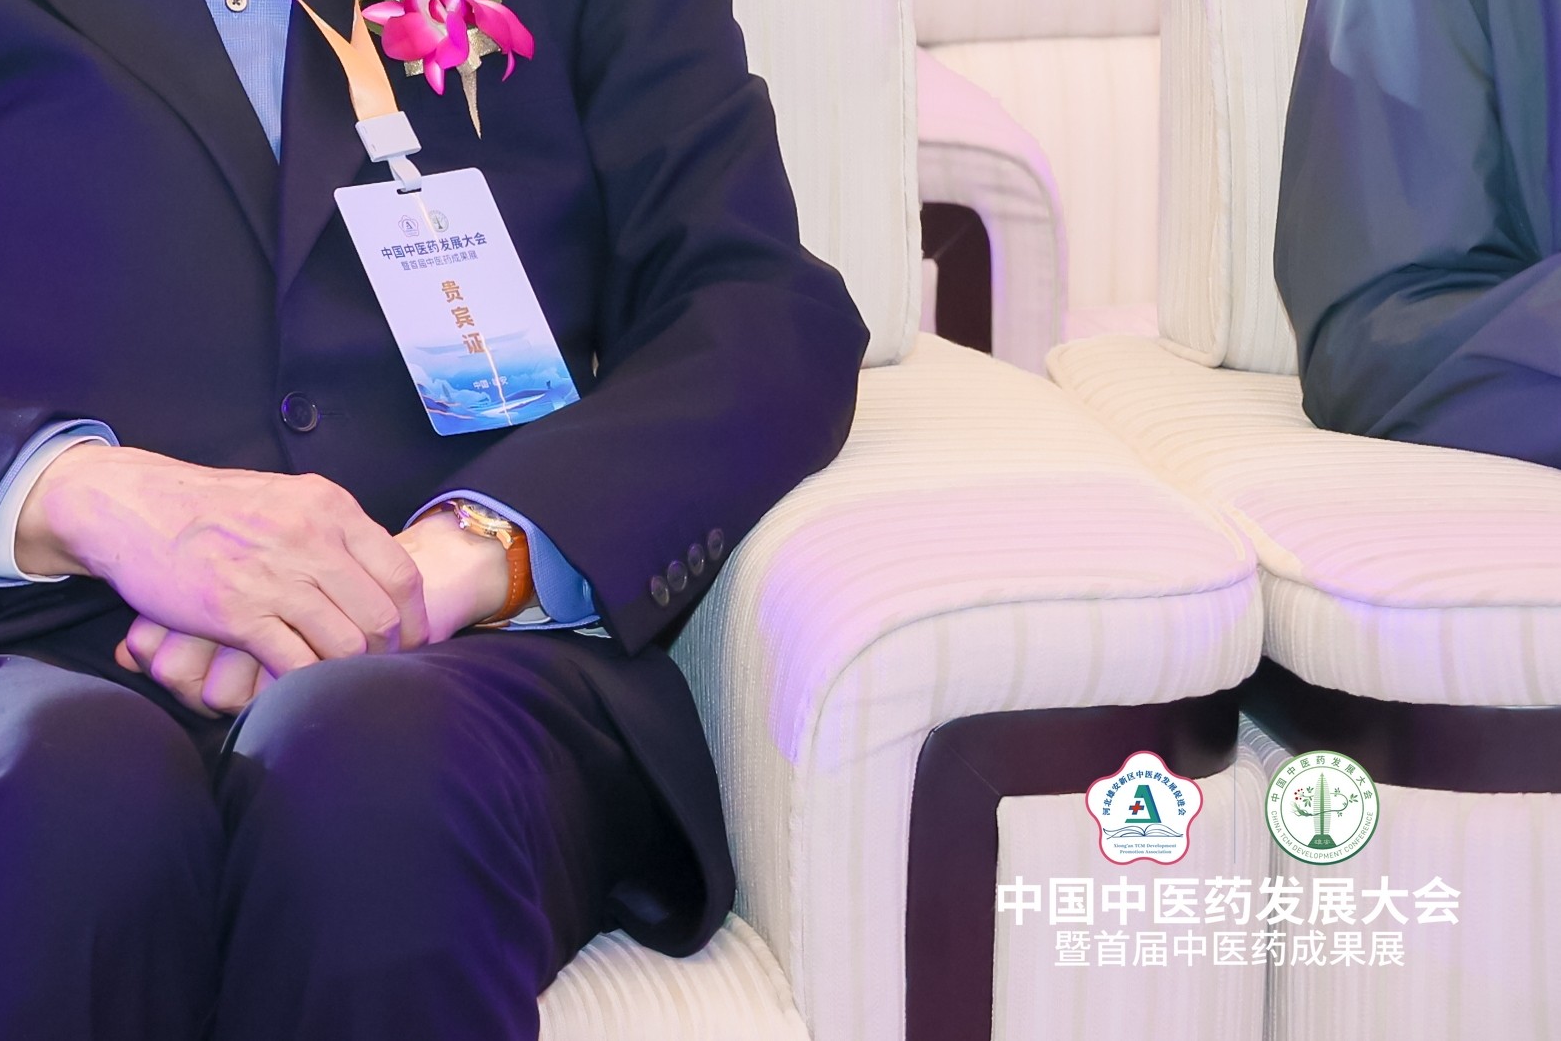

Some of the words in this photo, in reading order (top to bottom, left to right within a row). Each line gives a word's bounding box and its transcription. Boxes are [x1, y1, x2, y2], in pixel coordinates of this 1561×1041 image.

[381, 231, 488, 260] 中国中医药发展大会
[400, 249, 479, 271] 暨首届中医药成果展
[441, 280, 486, 354] 贵宾证
